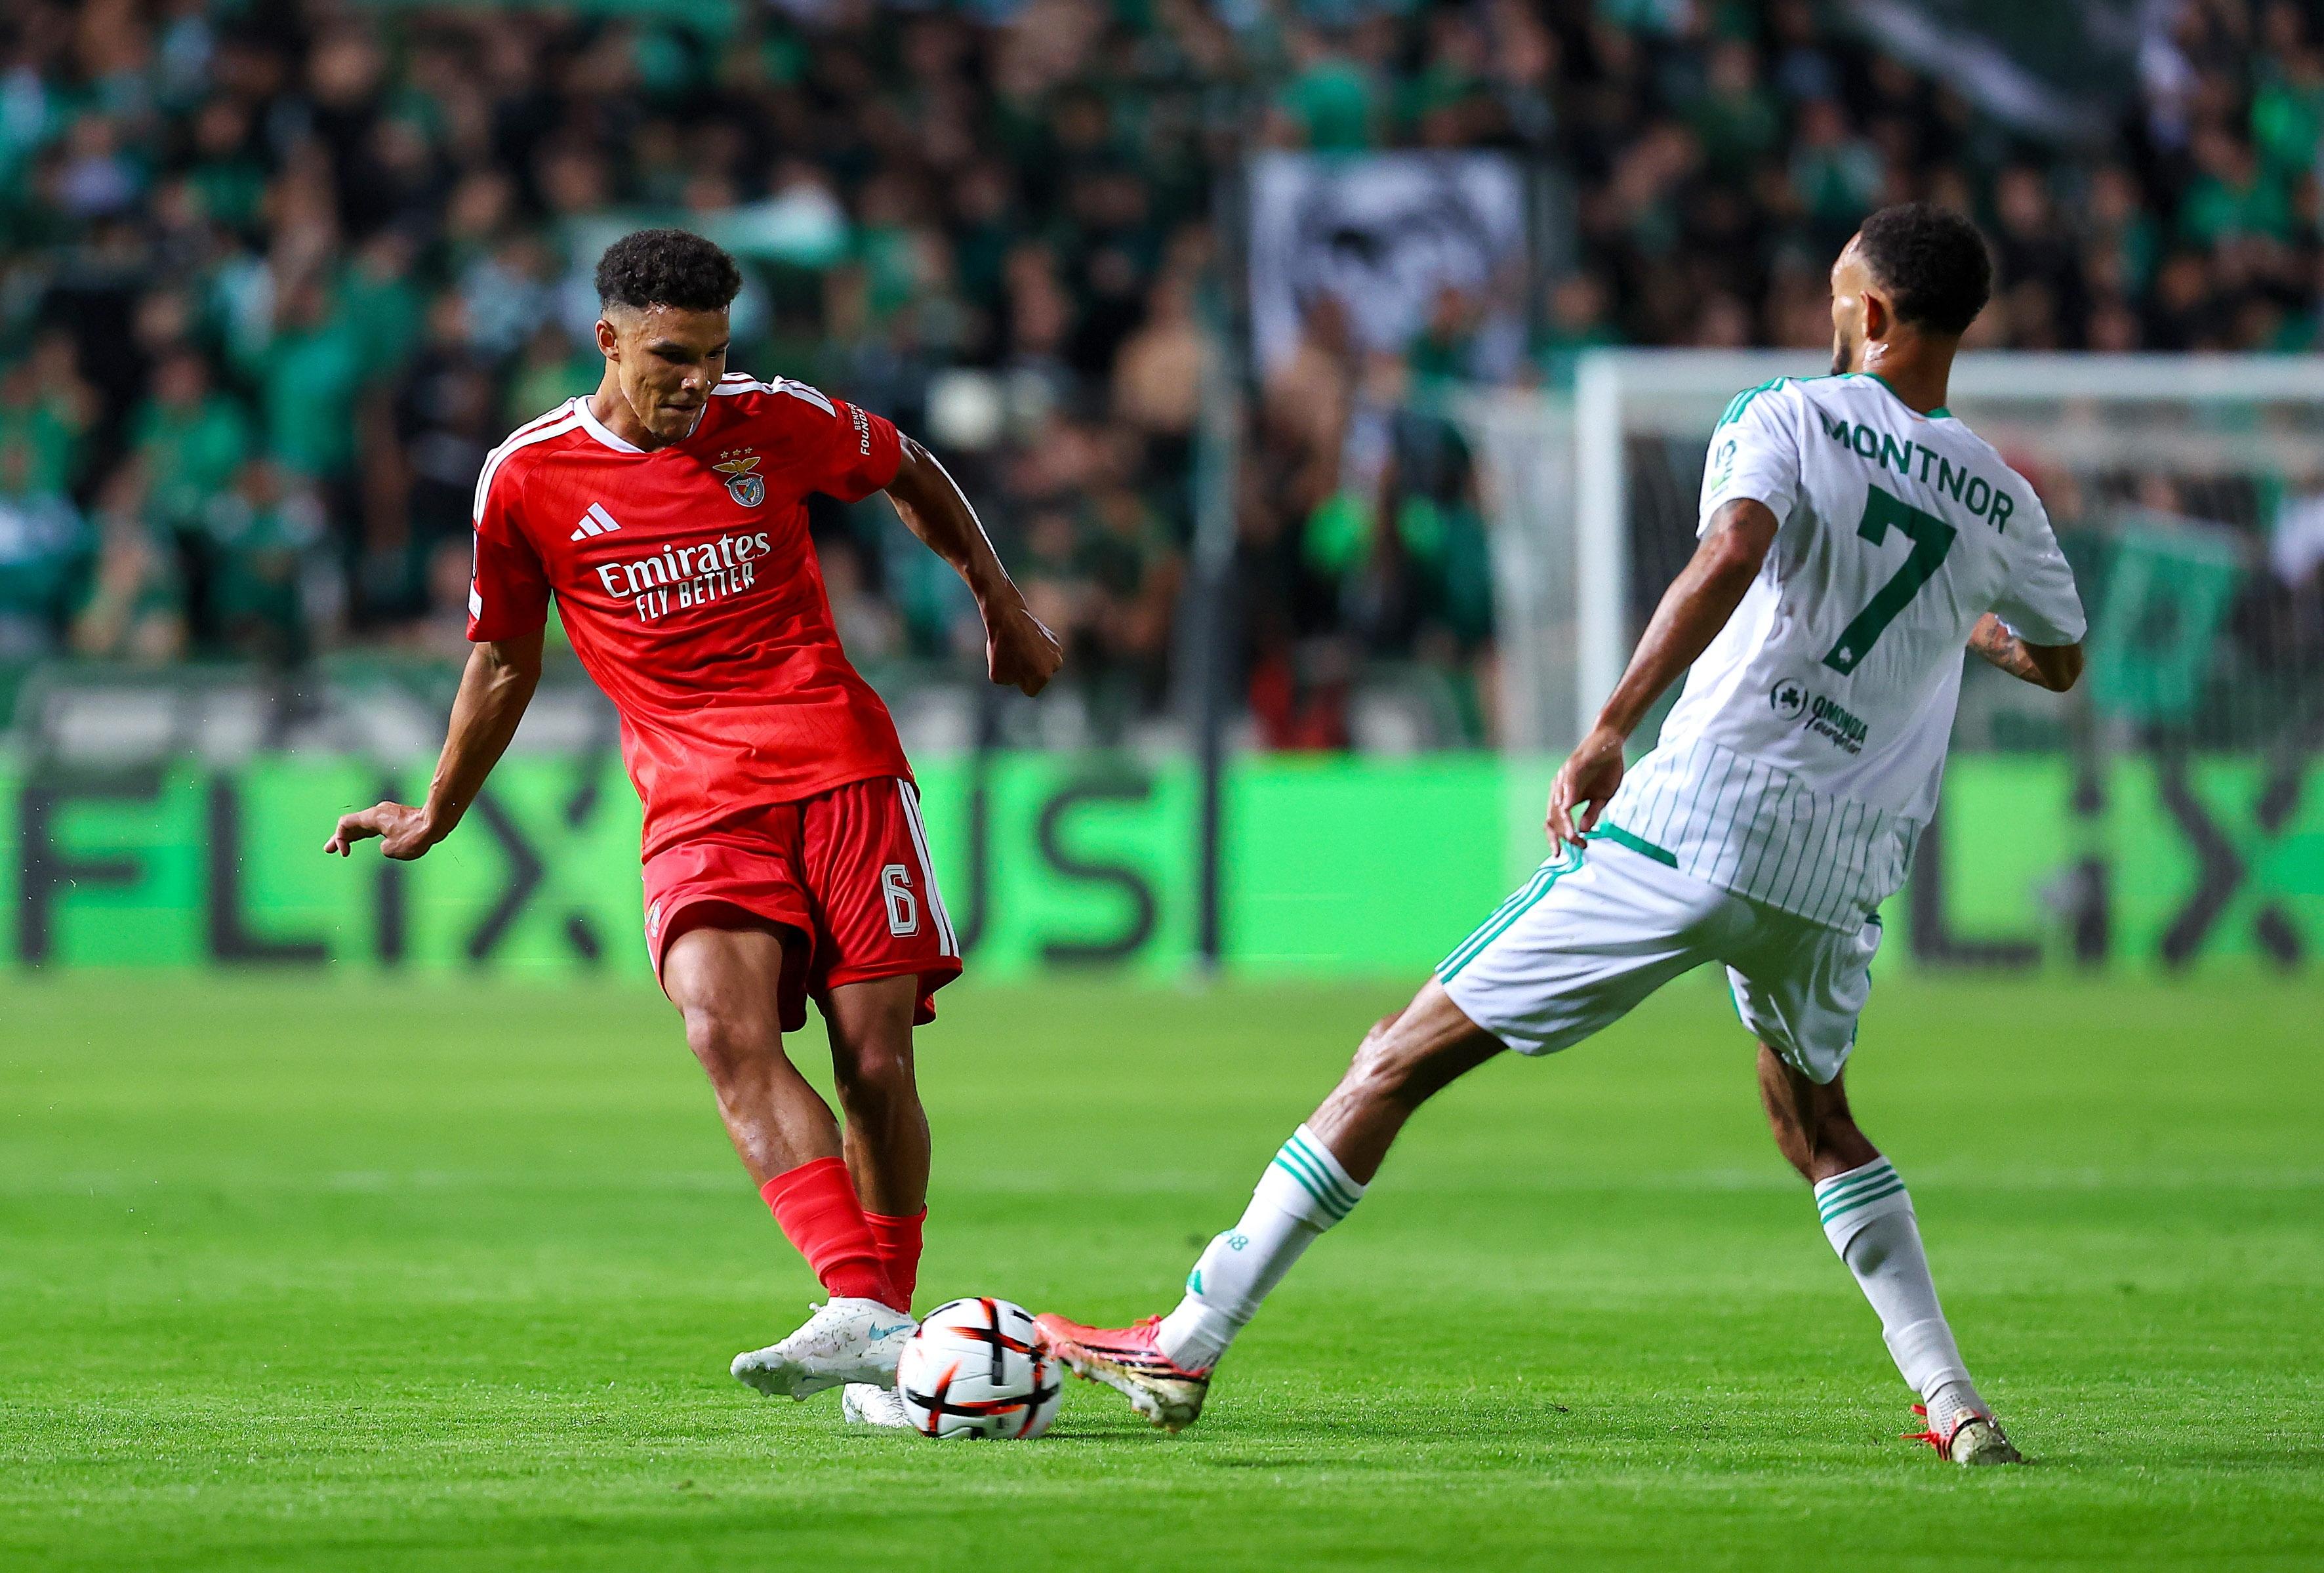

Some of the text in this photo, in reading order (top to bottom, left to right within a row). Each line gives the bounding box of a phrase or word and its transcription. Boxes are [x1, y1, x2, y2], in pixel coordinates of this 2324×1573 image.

[1819, 411, 2014, 535] MONTNOR
[595, 532, 771, 598] Emirates
[635, 562, 755, 622] FLY BETTER
[1822, 482, 1958, 676] 7
[881, 864, 920, 938] 6
